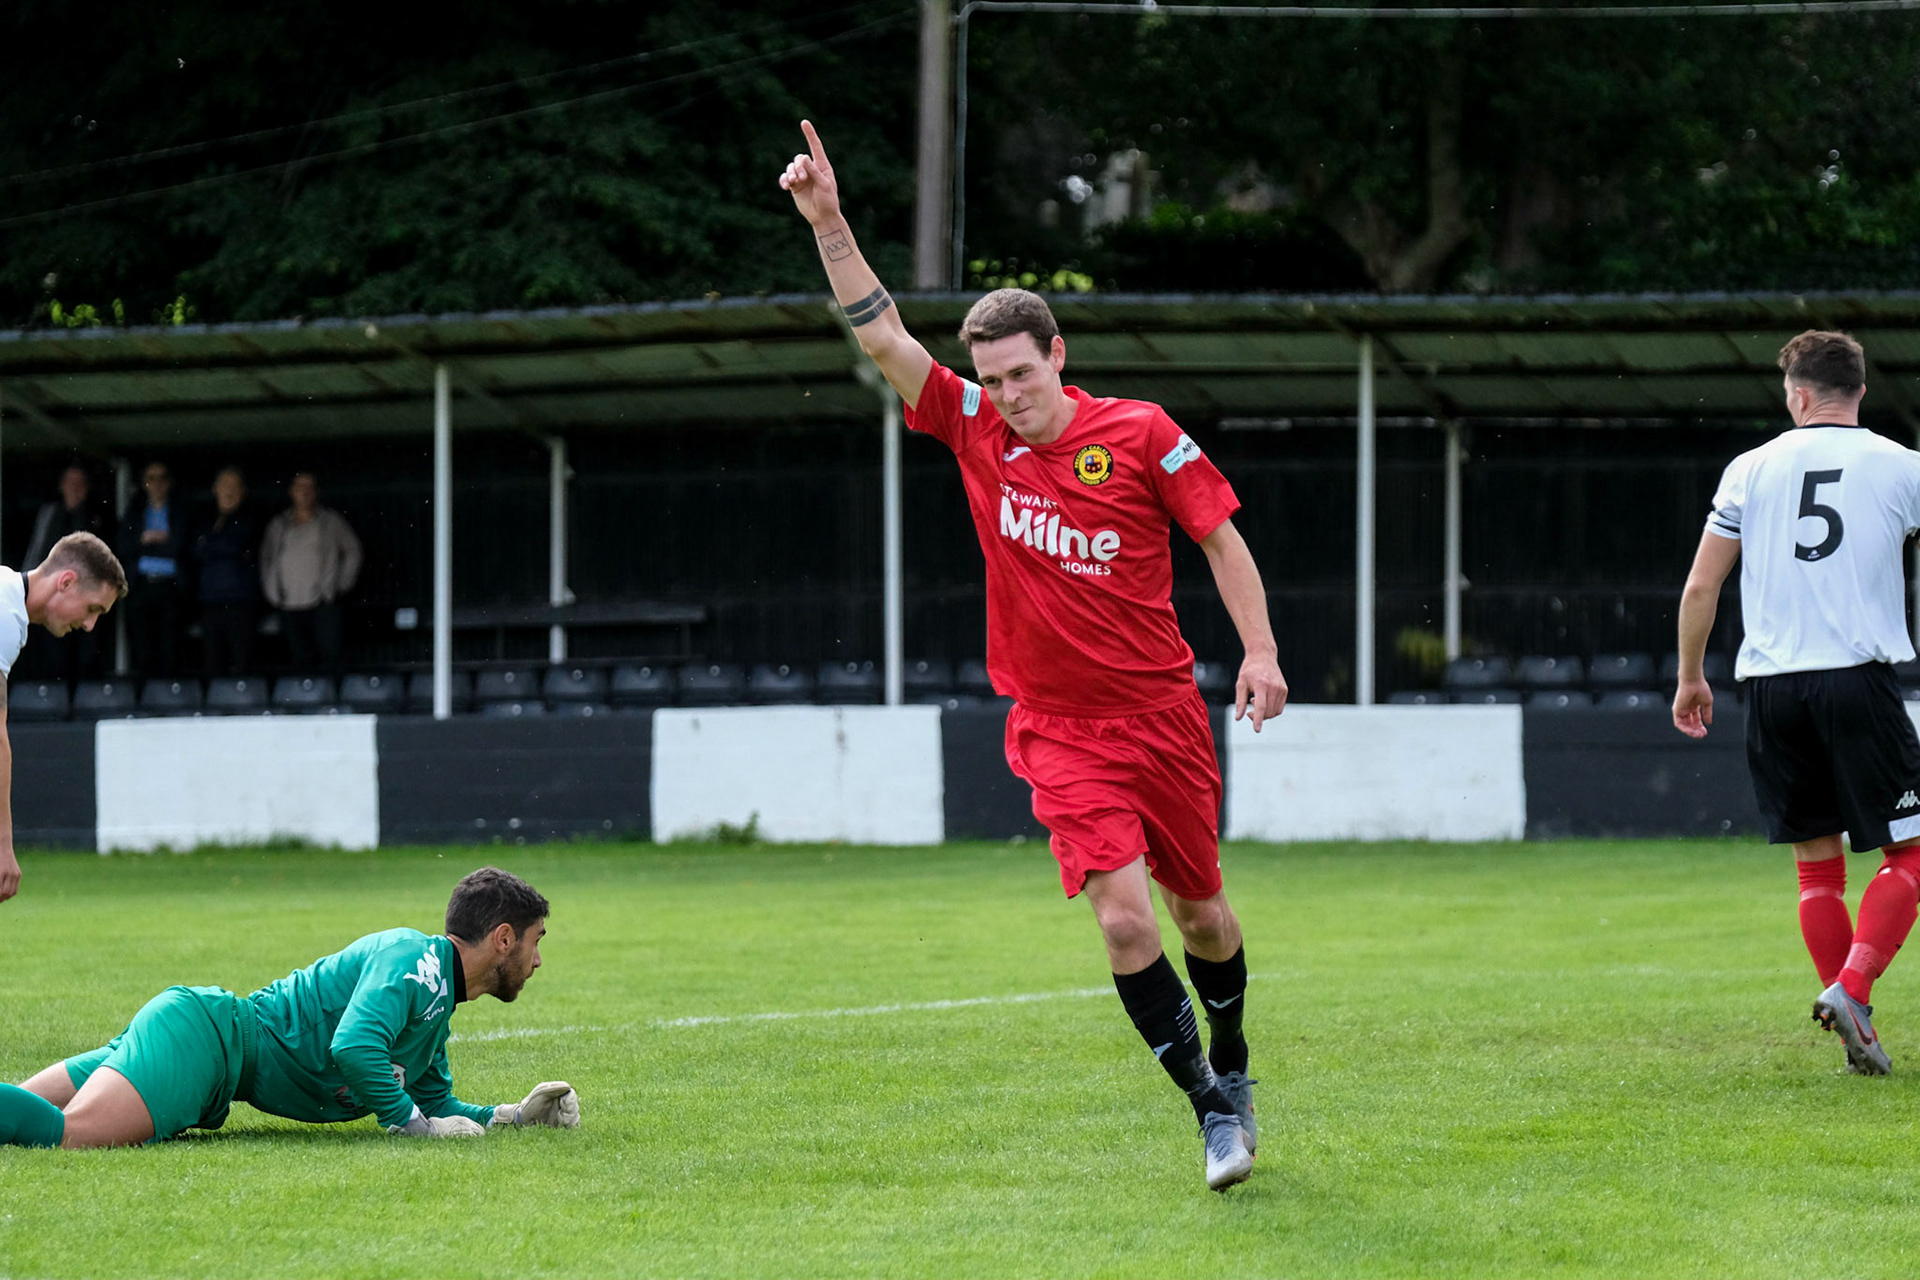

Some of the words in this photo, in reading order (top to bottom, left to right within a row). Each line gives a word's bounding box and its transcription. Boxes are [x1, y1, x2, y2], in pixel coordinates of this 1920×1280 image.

[1000, 495, 1121, 560] Milne
[1794, 468, 1845, 562] 5
[1060, 561, 1112, 575] HOMES
